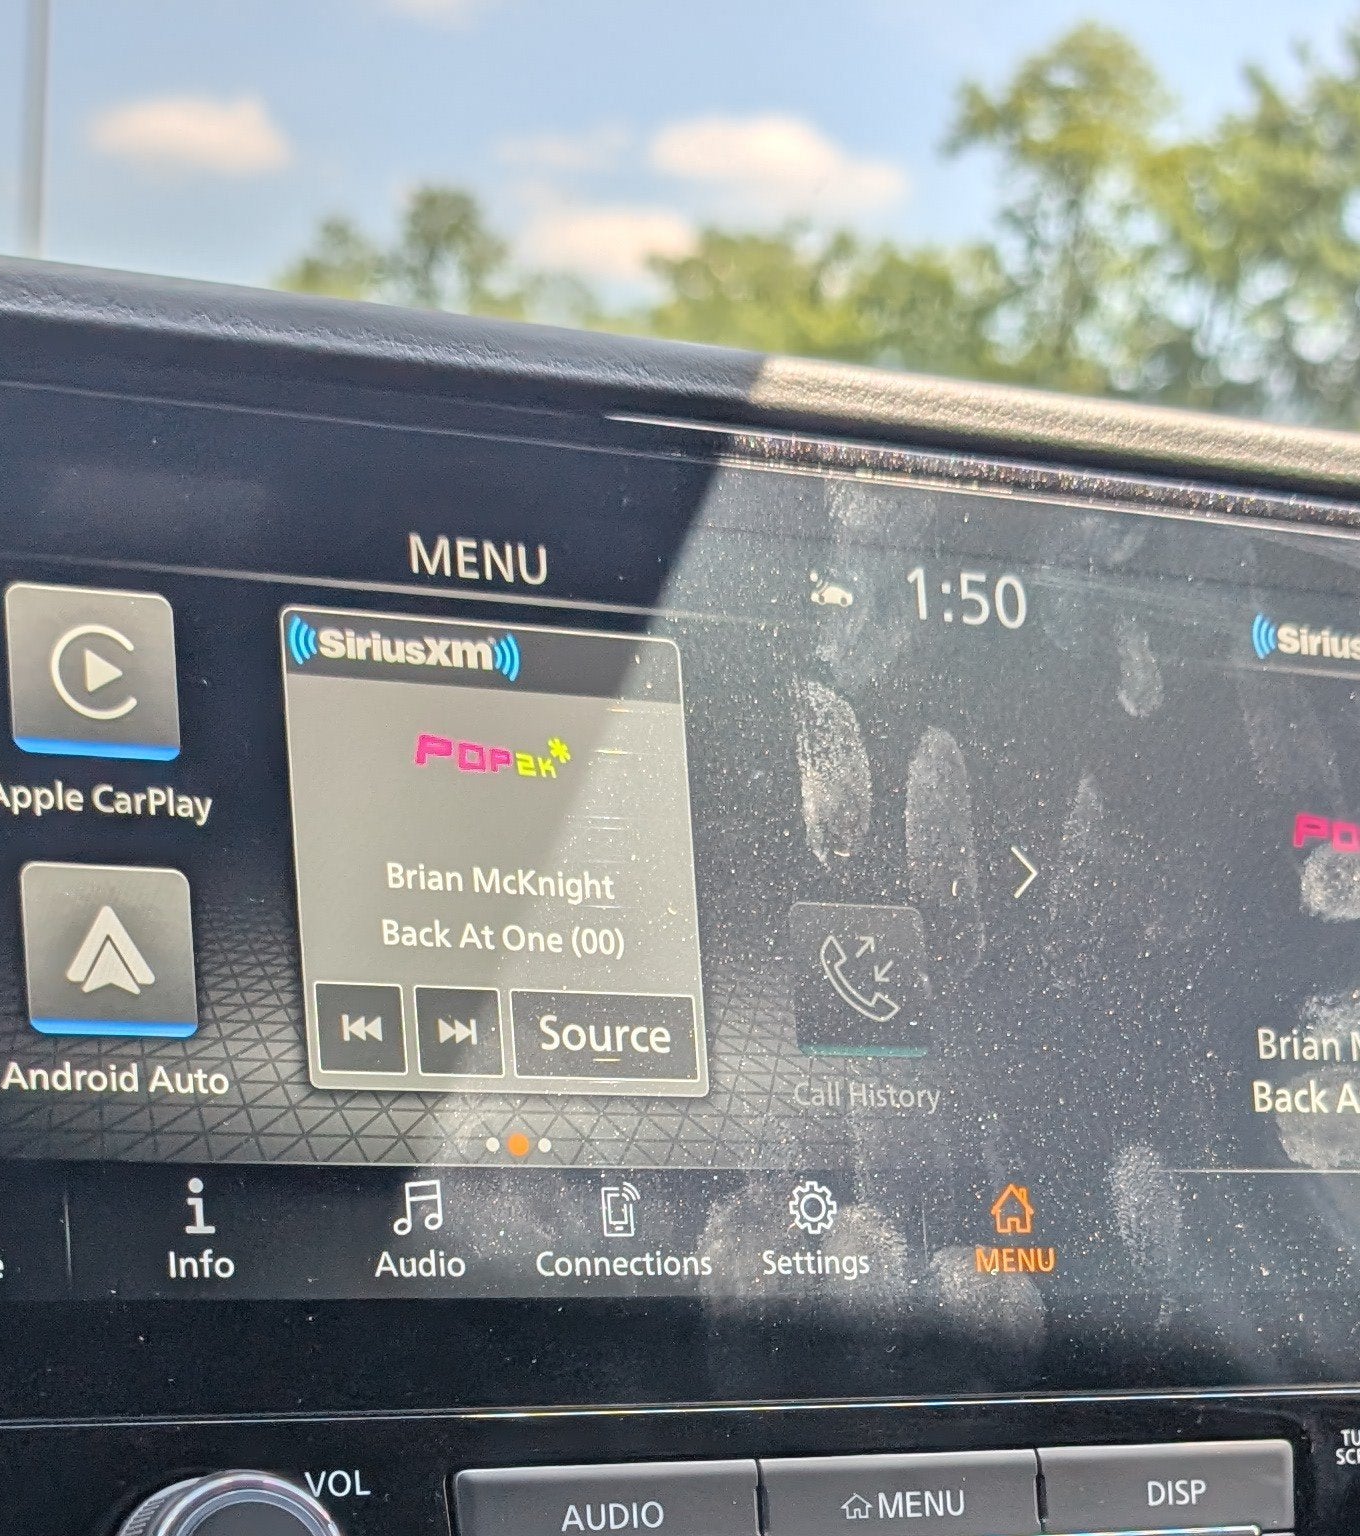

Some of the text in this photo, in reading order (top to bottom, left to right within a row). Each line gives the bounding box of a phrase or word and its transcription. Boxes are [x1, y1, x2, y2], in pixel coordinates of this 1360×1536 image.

[407, 533, 550, 585] MENU
[905, 564, 1028, 630] 1:50
[91, 784, 213, 826] CarPlay
[386, 862, 615, 904] Brian McKnight
[381, 918, 626, 961] Back At One (00)
[539, 1013, 672, 1056] Source
[1256, 1028, 1342, 1065] Brian
[1, 1061, 230, 1096] Android Auto
[794, 1082, 941, 1117] Call History
[1252, 1082, 1327, 1117] Back
[168, 1249, 235, 1281] Info
[374, 1248, 467, 1279] Audio
[535, 1250, 714, 1280] Connections
[762, 1248, 870, 1283] Settings
[975, 1246, 1056, 1275] MENU
[305, 1470, 371, 1498] VOL
[1146, 1480, 1207, 1506] DISP
[561, 1501, 665, 1534] AUDIO
[877, 1489, 966, 1520] MENU
